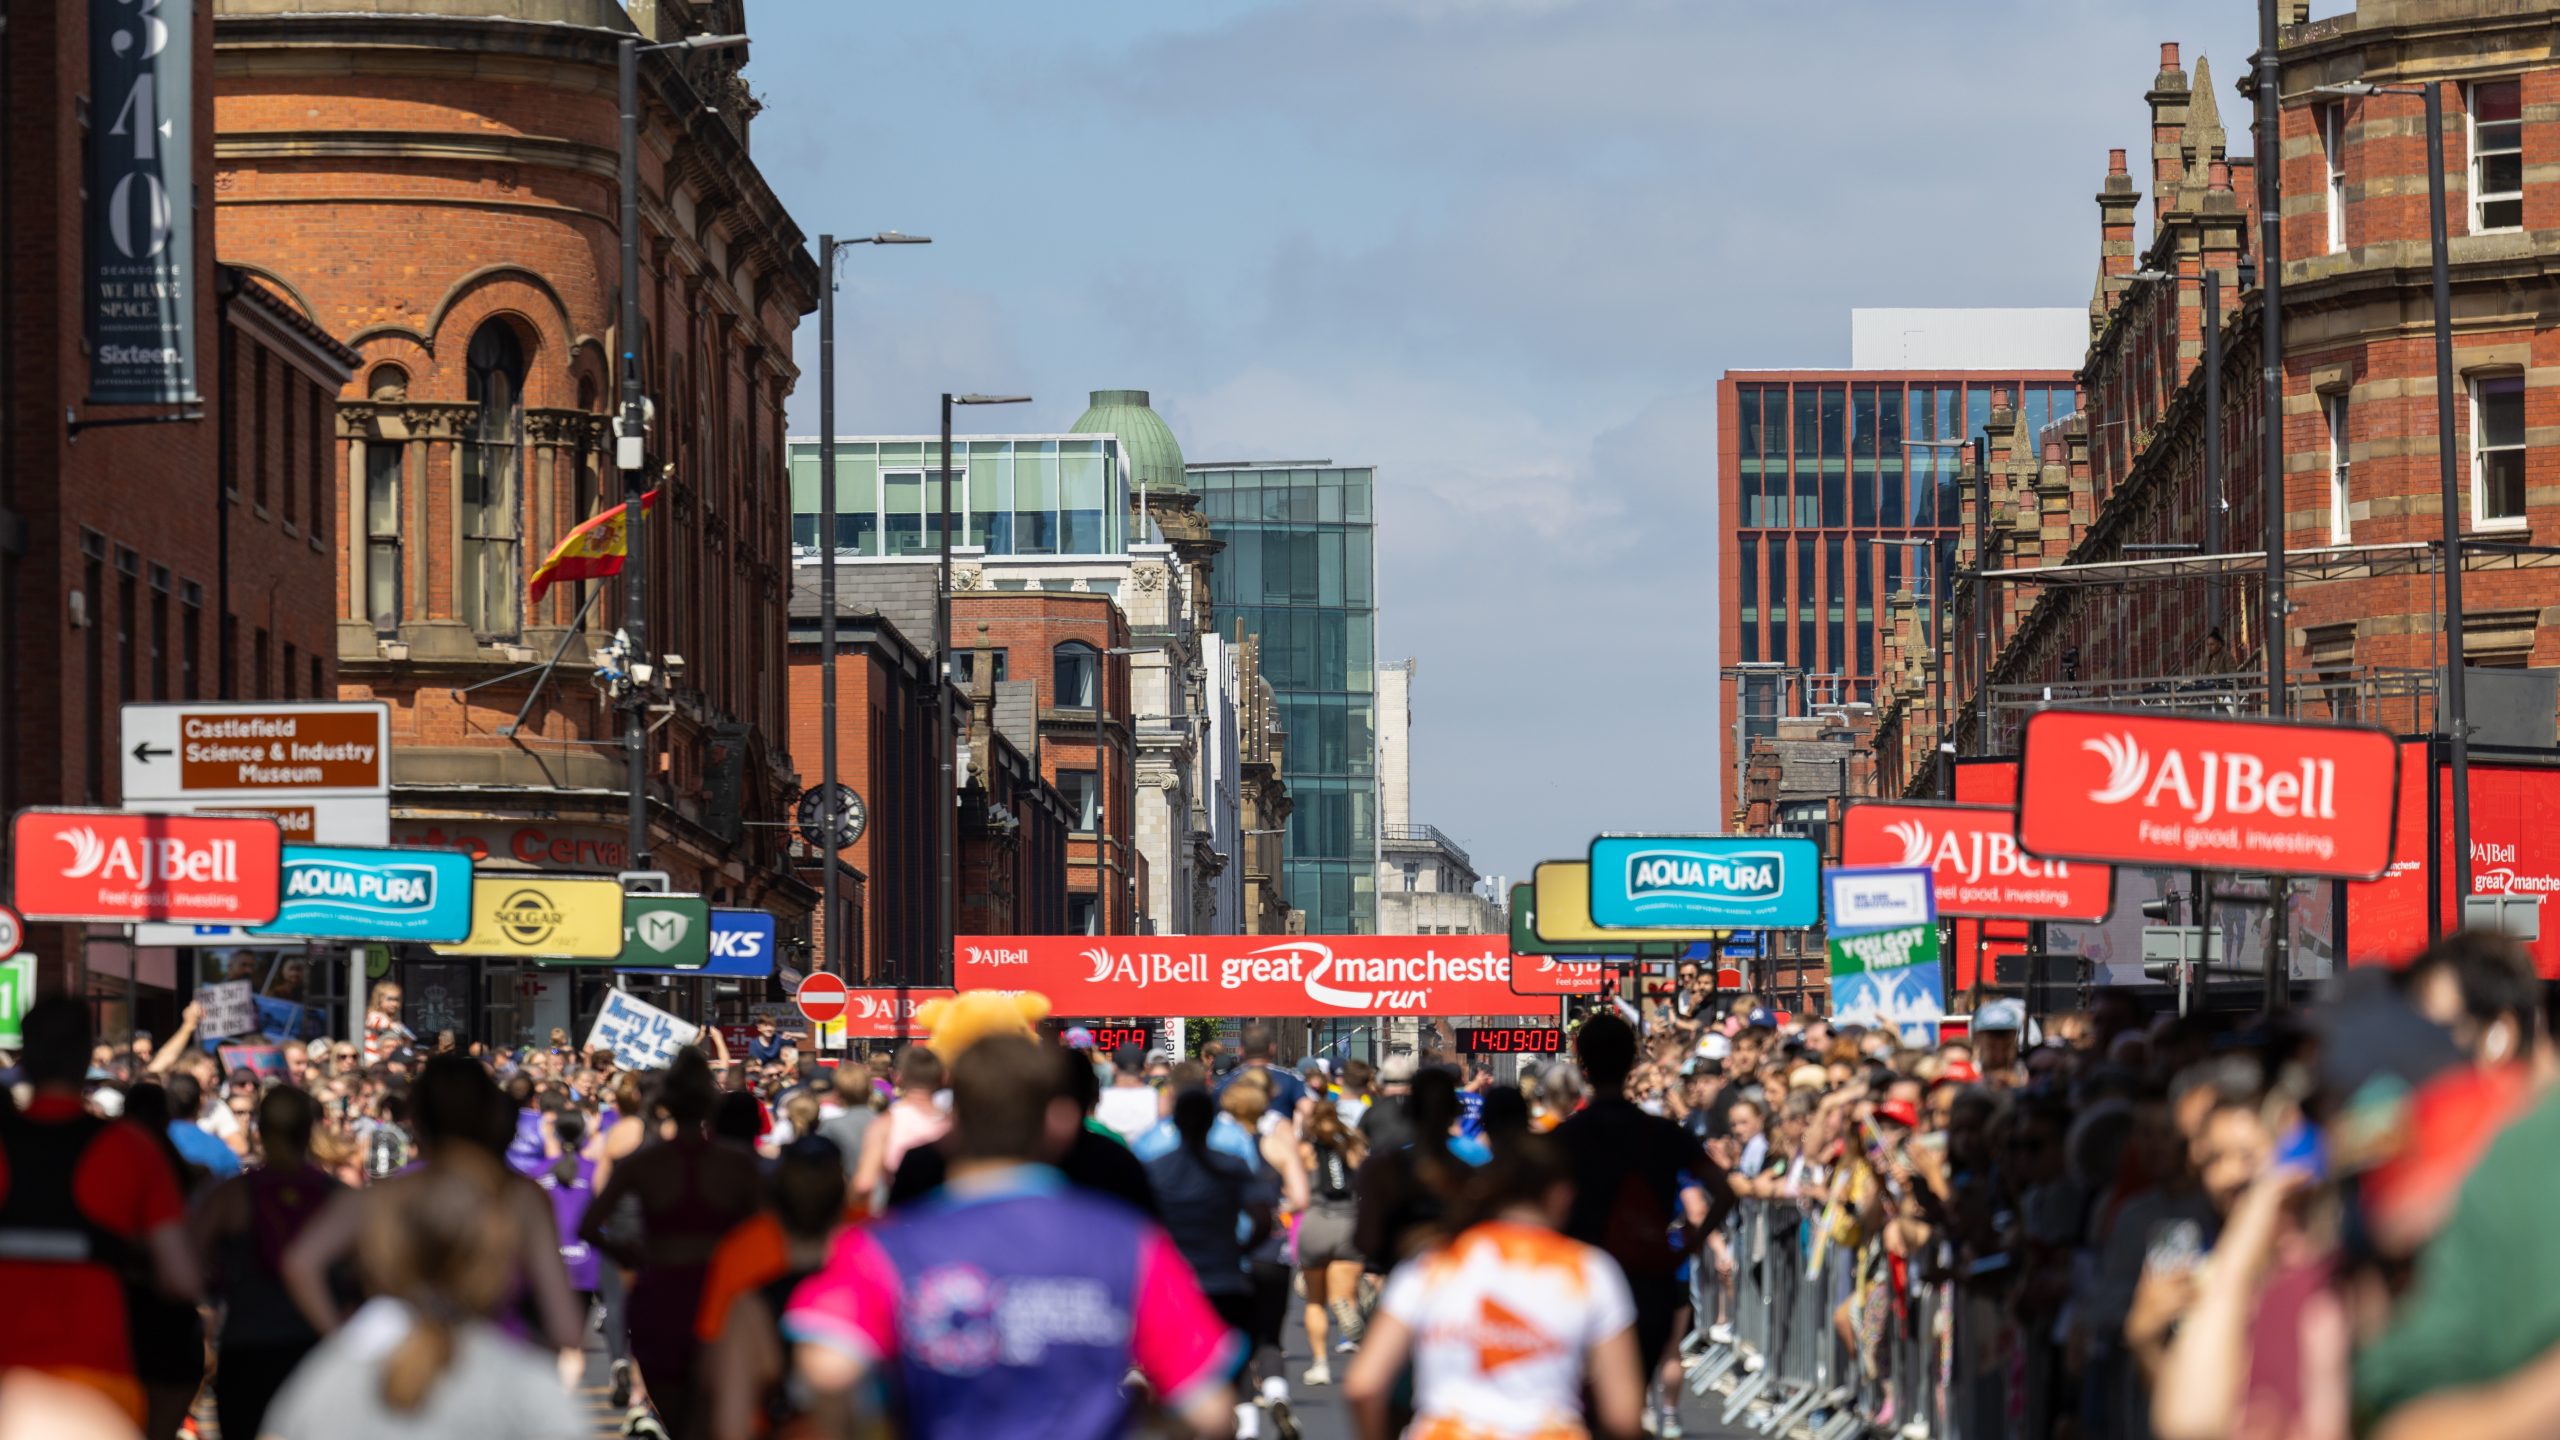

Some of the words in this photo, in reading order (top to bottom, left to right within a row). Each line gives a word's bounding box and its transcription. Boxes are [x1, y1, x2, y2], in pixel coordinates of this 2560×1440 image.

[100, 283, 127, 298] WE
[133, 282, 181, 298] HAVE
[100, 345, 184, 364] Sixteen.
[185, 718, 296, 738] Castlefield
[186, 742, 265, 762] Science
[269, 742, 286, 761] &
[291, 741, 375, 764] Industry
[239, 764, 323, 783] Museum
[2139, 819, 2180, 843] Feel
[2184, 826, 2242, 851] good,
[1635, 859, 1705, 888] AQUA
[1708, 863, 1774, 891] PURA
[2475, 875, 2504, 892] great
[98, 888, 129, 905] Feel
[287, 868, 357, 898] AQUA
[359, 873, 427, 904] PURA
[1934, 884, 1957, 899] eel
[1959, 886, 2001, 904] good,
[493, 911, 563, 926] SOLGAR
[1840, 934, 1882, 959] YOU
[1883, 927, 1924, 951] GOT
[1221, 951, 1303, 989] great
[1335, 950, 1511, 982] mancheste
[652, 1014, 672, 1047] Up
[1472, 1029, 1559, 1052] 14:09:08
